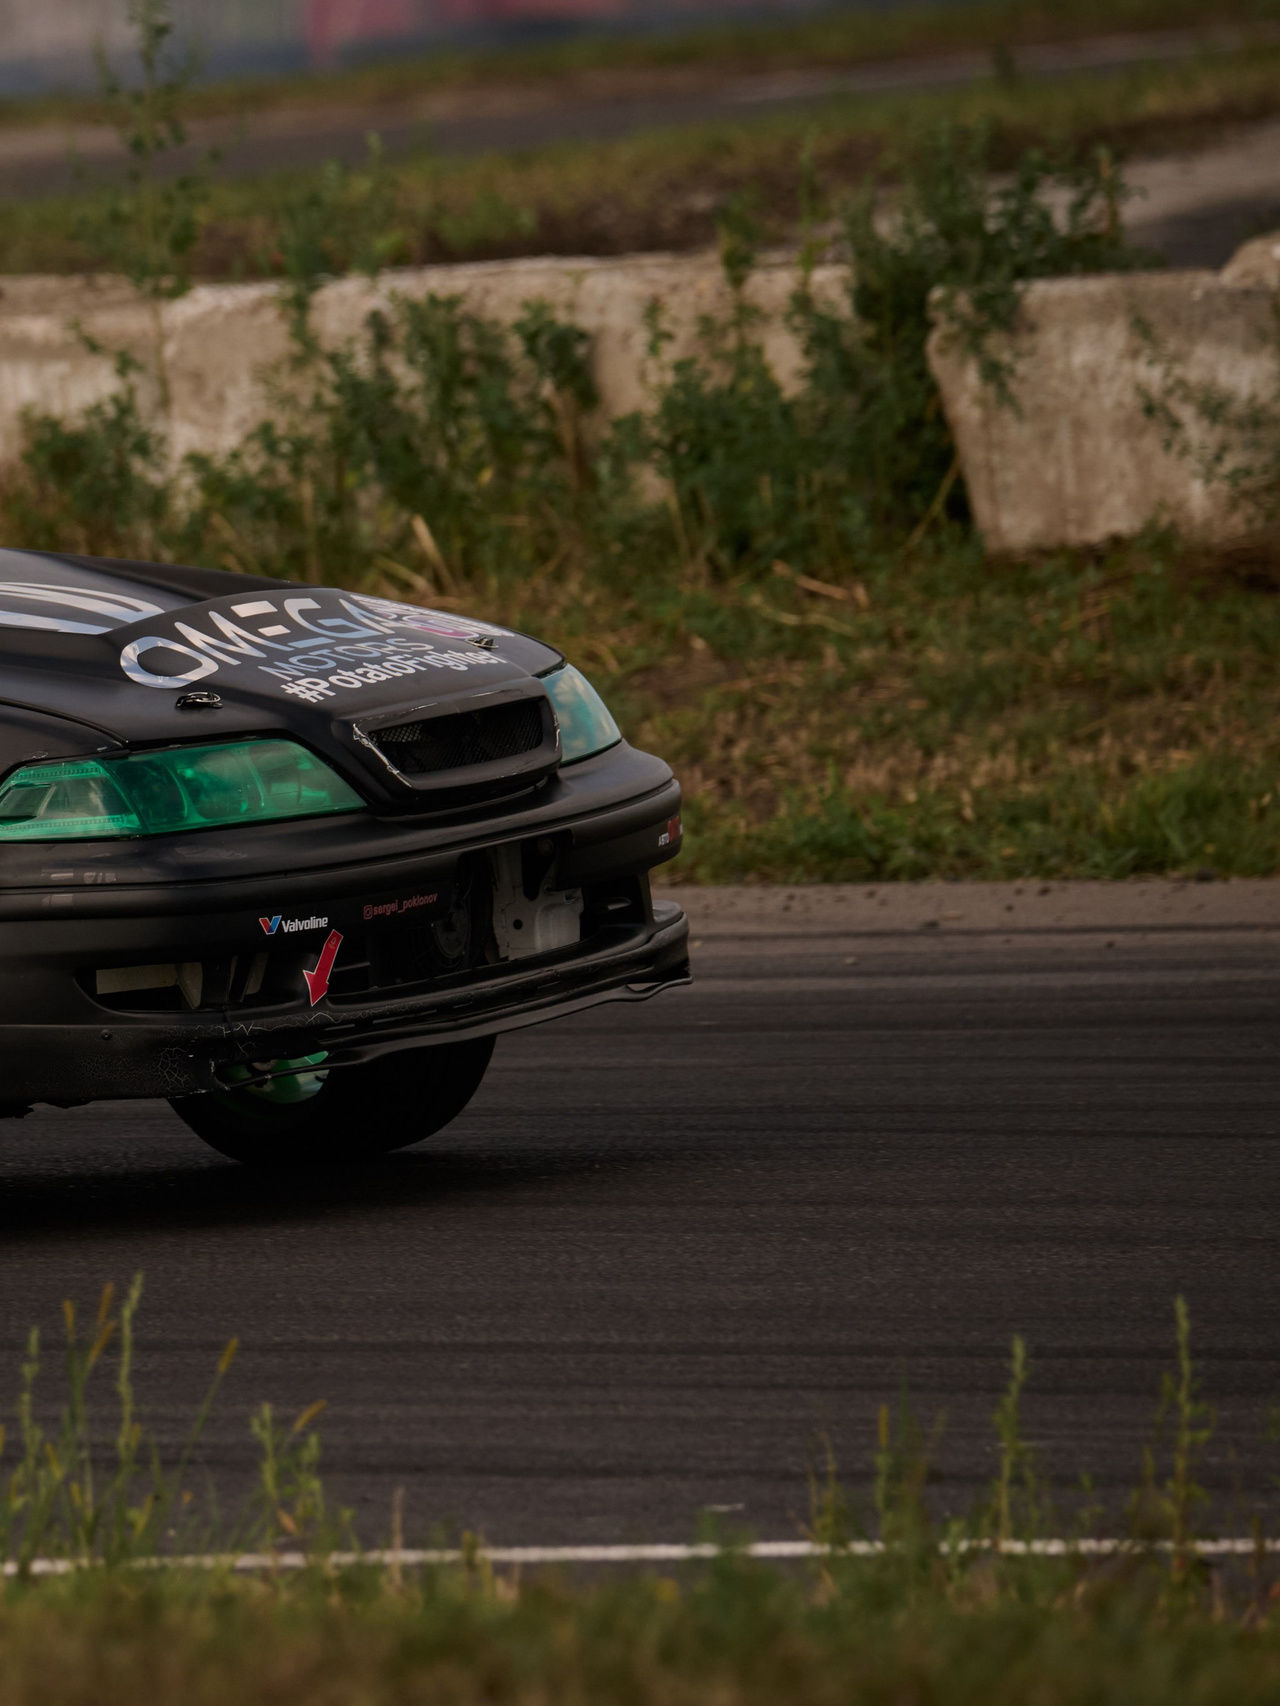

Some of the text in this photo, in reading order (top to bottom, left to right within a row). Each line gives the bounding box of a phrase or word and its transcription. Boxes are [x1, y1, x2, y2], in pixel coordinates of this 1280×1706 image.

[120, 597, 396, 689] OMEGA
[257, 637, 435, 681] MOTORS
[280, 649, 509, 703] #PotatoFighter
[281, 915, 329, 933] Valvoline
